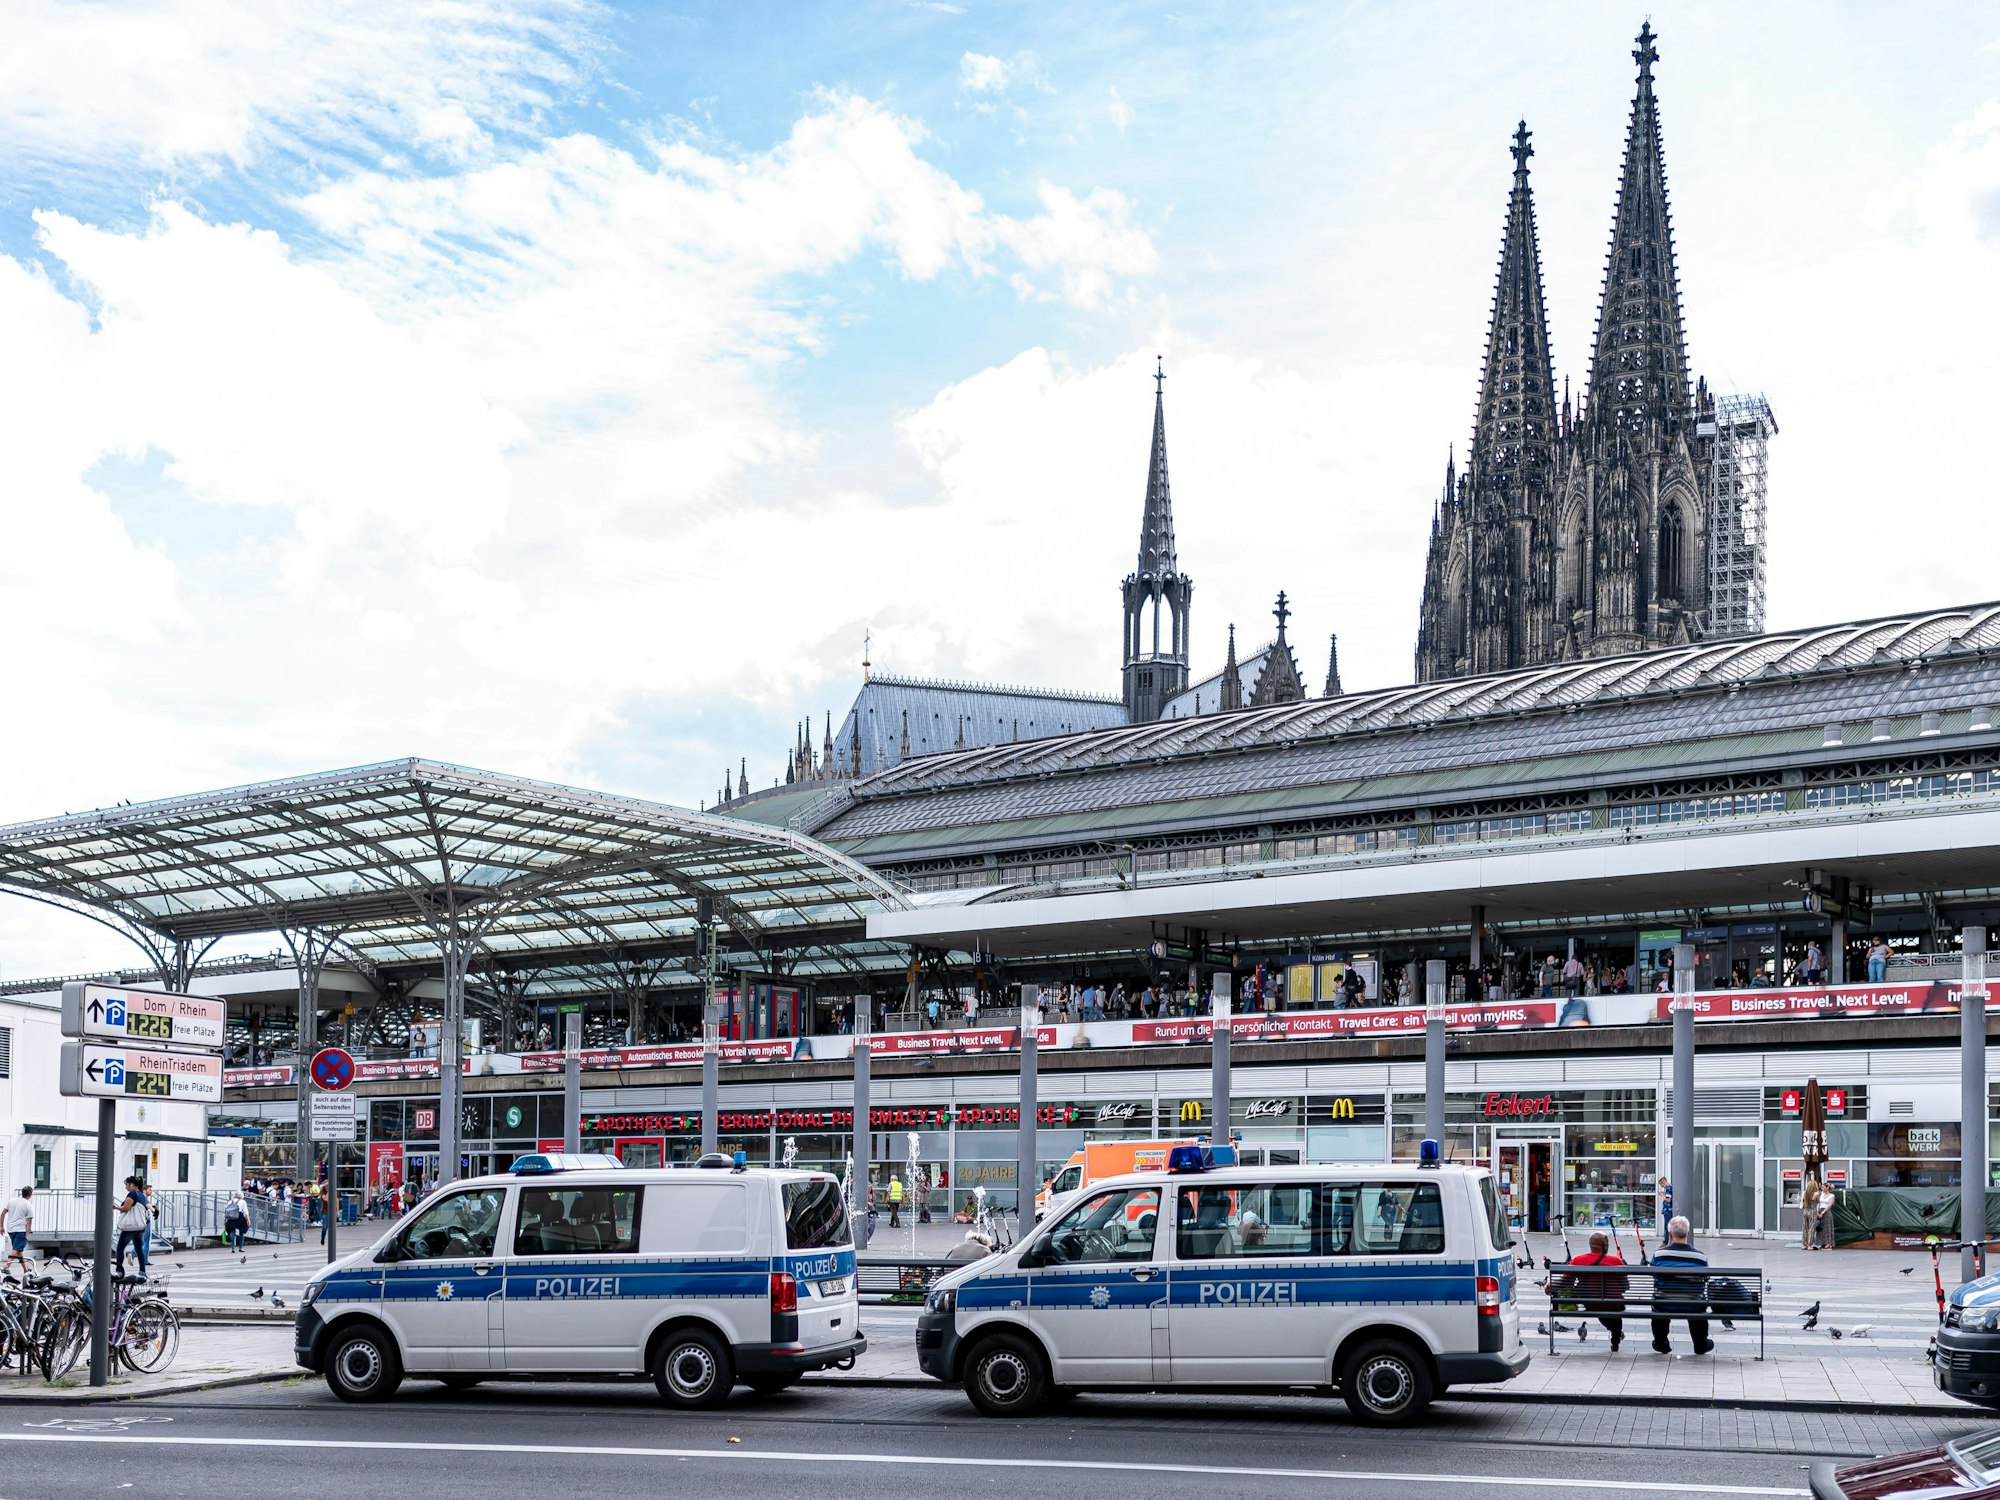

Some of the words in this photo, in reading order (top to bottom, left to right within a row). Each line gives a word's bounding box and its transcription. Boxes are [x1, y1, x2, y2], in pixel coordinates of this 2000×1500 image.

[144, 998, 166, 1013] Dom
[170, 1002, 176, 1014] /
[180, 1002, 207, 1017] Rhein
[1732, 998, 1786, 1012] Business
[1788, 996, 1833, 1010] Travel.
[1836, 994, 1869, 1008] Next
[1872, 991, 1912, 1006] Level.
[1338, 1016, 1372, 1028] Travel
[1373, 1016, 1398, 1027] Care:
[1403, 1014, 1420, 1026] ein
[1422, 1012, 1458, 1025] Veil
[1461, 1013, 1481, 1024] von
[1484, 1009, 1527, 1024] myHRS.
[128, 1016, 170, 1038] 1226
[174, 1024, 191, 1035] freie
[193, 1026, 216, 1037] Plätze
[1155, 1026, 1178, 1037] Rund
[1180, 1027, 1194, 1036] um
[1196, 1024, 1211, 1035] die
[1233, 1019, 1290, 1034] persönlicher
[1293, 1019, 1333, 1031] Kontakt.
[897, 1038, 930, 1048] Business
[932, 1036, 958, 1047] Travel.
[959, 1036, 978, 1045] Next
[980, 1034, 1003, 1045] Level.
[627, 1051, 673, 1062] Automatisches
[724, 1046, 747, 1057] Vorteil
[748, 1047, 761, 1056] von
[762, 1045, 789, 1057] myHRS.
[140, 1056, 207, 1073] RheinTriadem
[588, 1055, 623, 1064] mitnehmen.
[236, 1073, 252, 1081] Vorteil
[263, 1072, 282, 1081] myHRS.
[362, 1066, 386, 1075] Business
[386, 1065, 404, 1074] Travel.
[405, 1064, 418, 1073] Next
[136, 1073, 169, 1095] 224
[172, 1082, 189, 1092] freie
[191, 1083, 214, 1093] Plätze
[417, 1113, 432, 1127] DB
[508, 1108, 519, 1125] S
[595, 1115, 673, 1131] APOTHEKE
[697, 1112, 825, 1130] ITERNATIONAL
[832, 1109, 928, 1126] PHRMACY
[958, 1106, 1056, 1124] APOTHKE
[1910, 1131, 1938, 1141] back
[1908, 1143, 1941, 1152] WERK
[959, 1167, 973, 1178] 20
[976, 1166, 1015, 1178] JAHRE
[795, 1259, 830, 1278] POLIZEI
[536, 1277, 620, 1297] POLIZEI
[1200, 1282, 1297, 1303] POLIZEI
